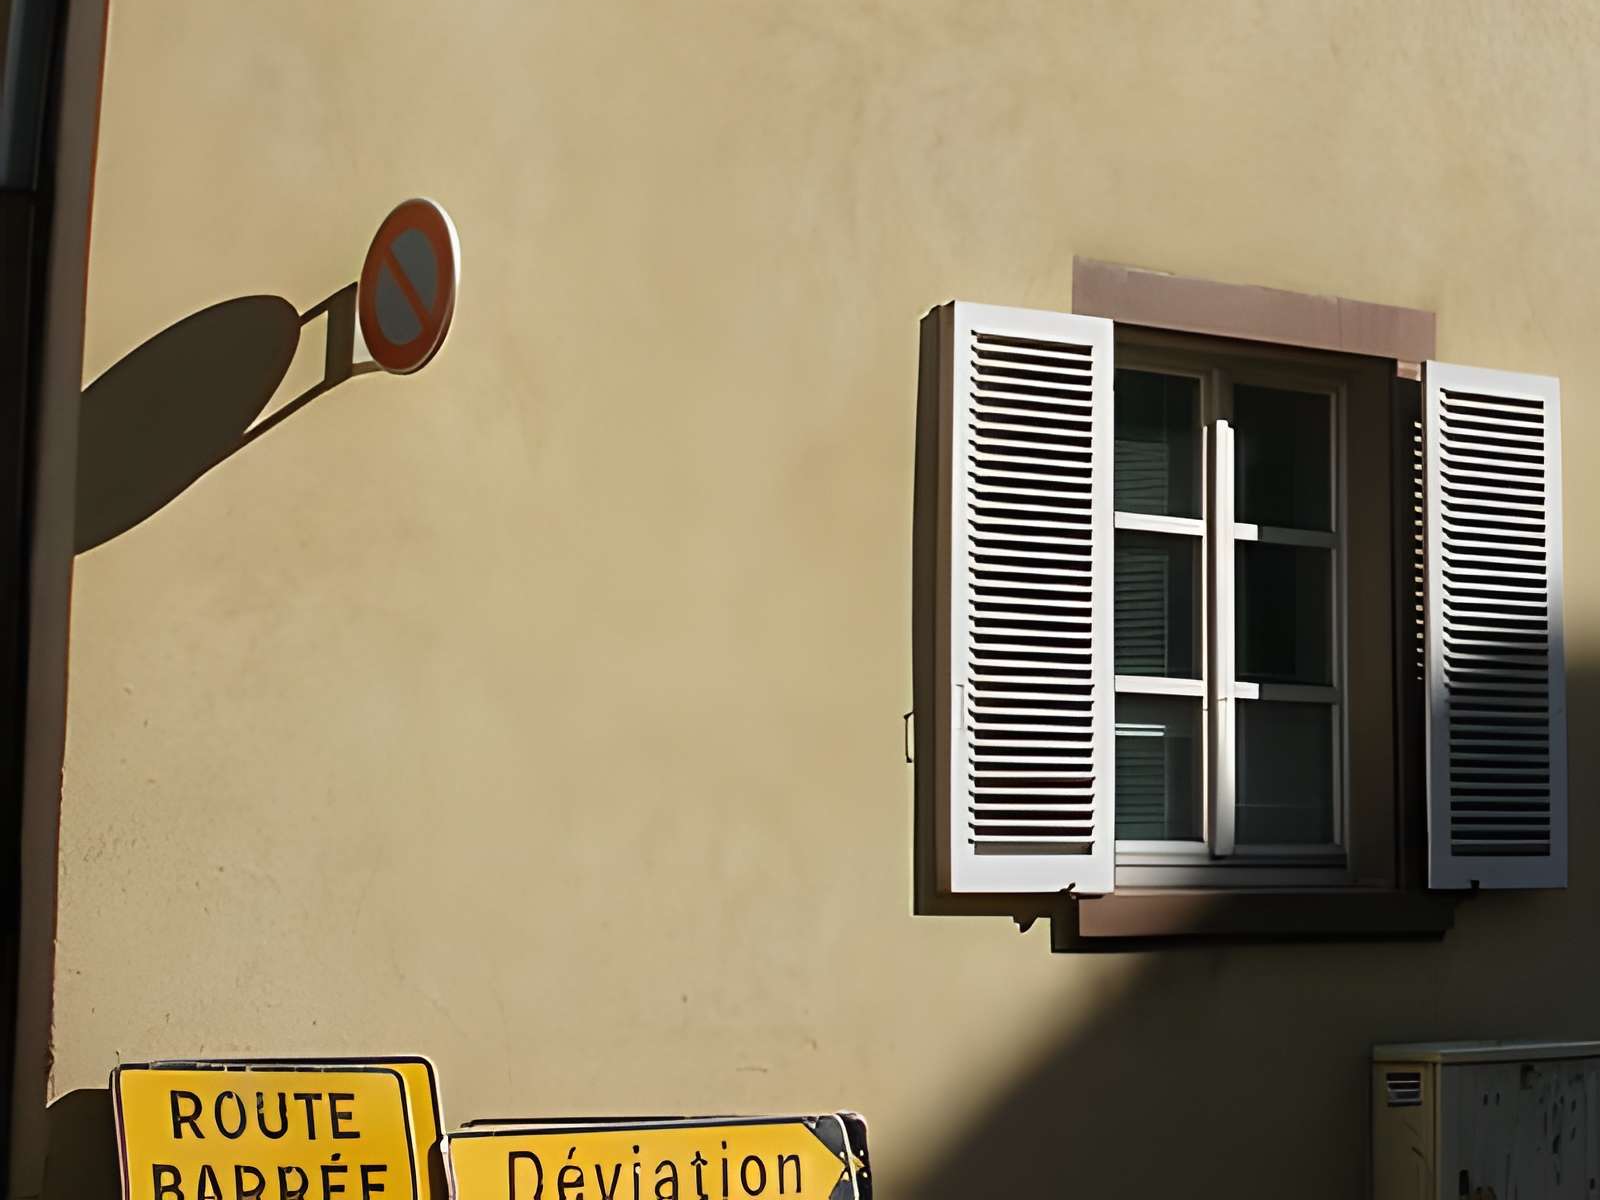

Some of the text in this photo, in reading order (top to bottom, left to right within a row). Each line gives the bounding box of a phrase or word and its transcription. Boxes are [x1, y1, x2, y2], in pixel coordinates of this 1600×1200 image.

[170, 1090, 361, 1140] ROUTE
[152, 1153, 388, 1200] BARRÉE
[507, 1140, 802, 1200] Déviation
